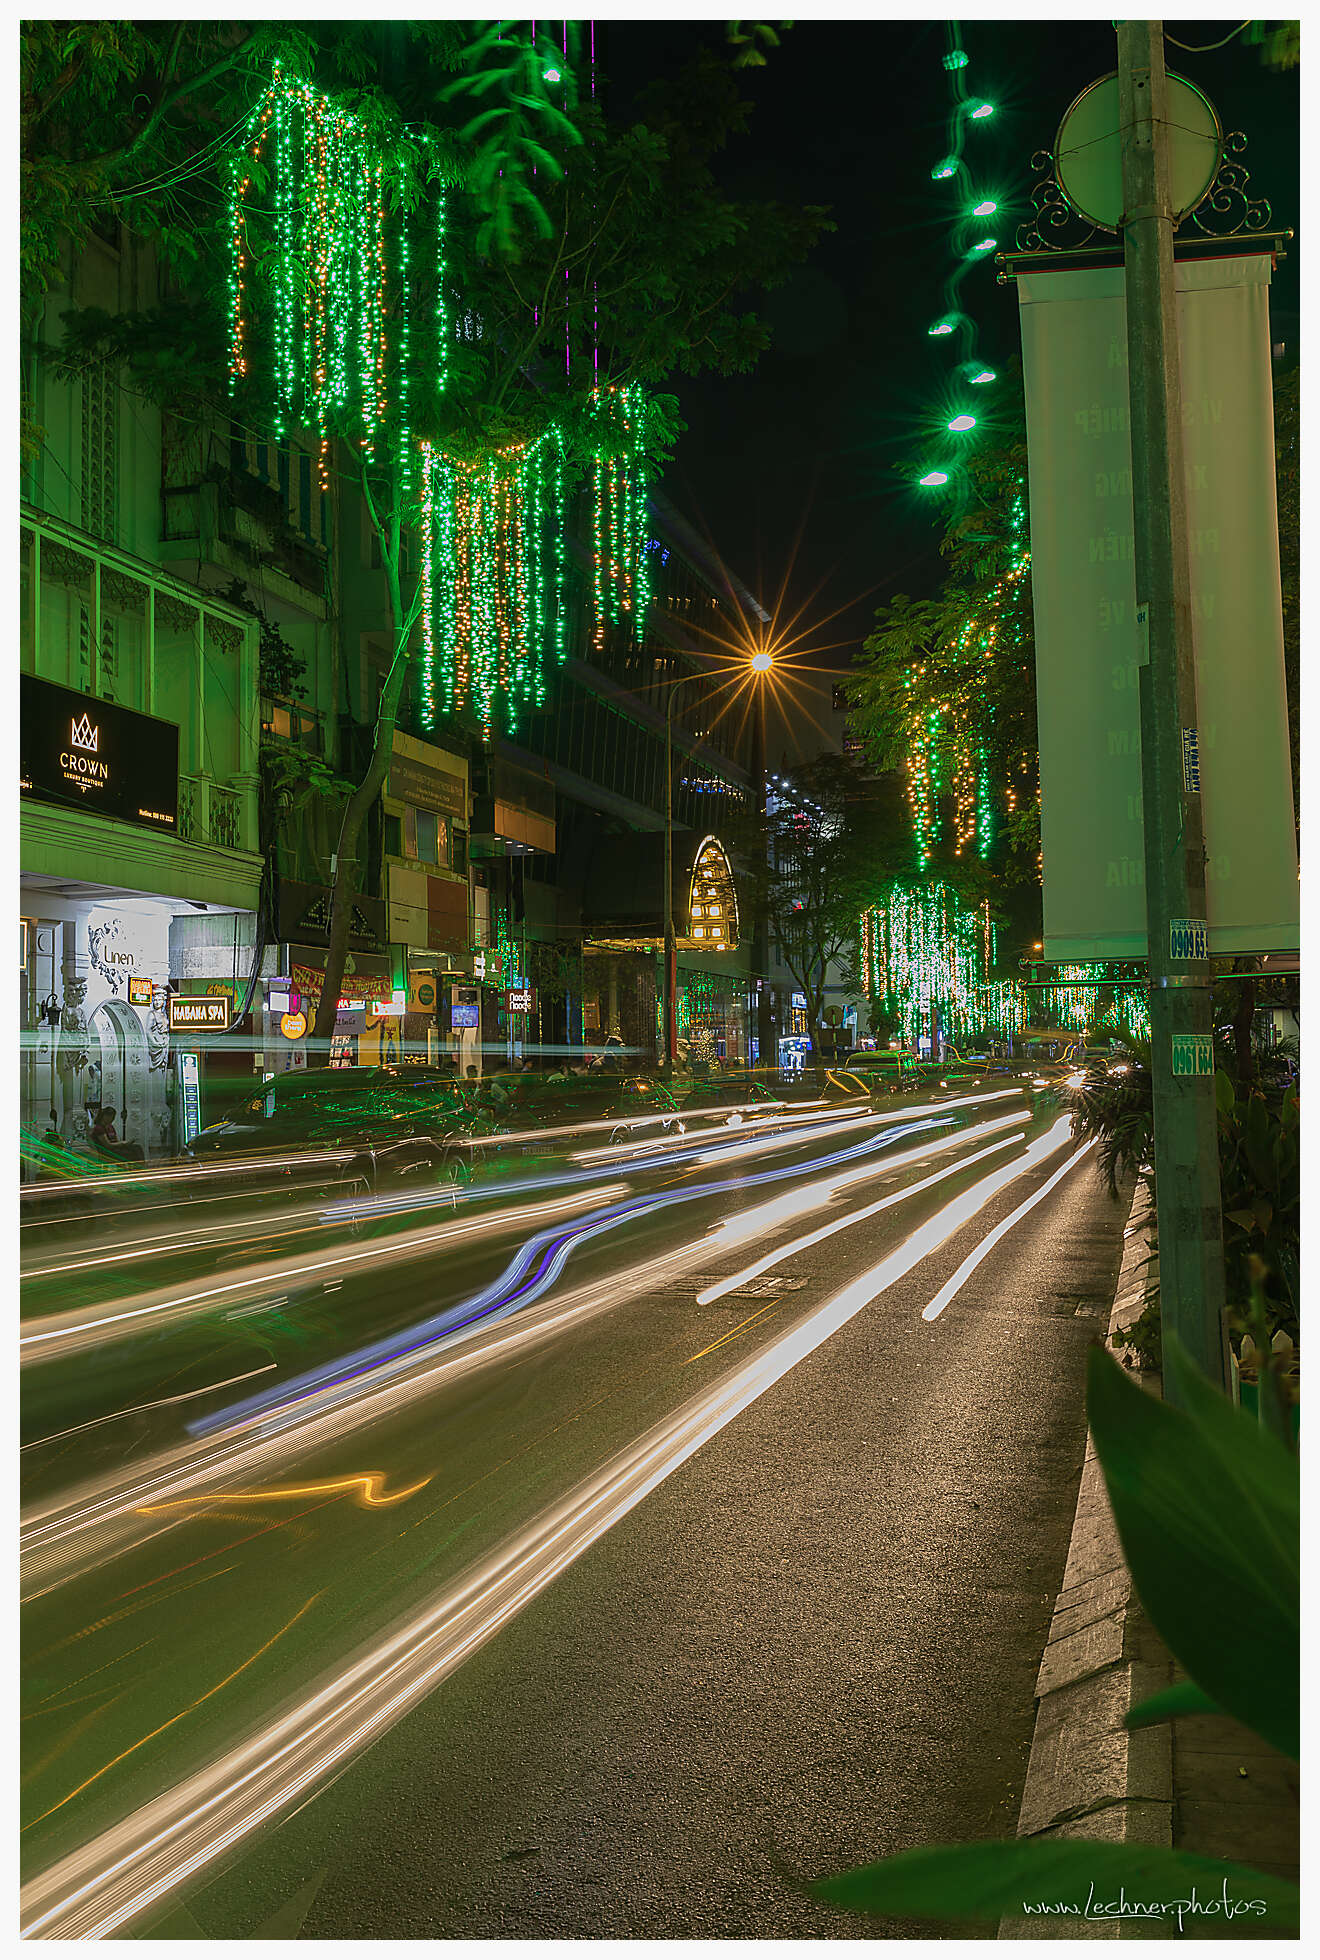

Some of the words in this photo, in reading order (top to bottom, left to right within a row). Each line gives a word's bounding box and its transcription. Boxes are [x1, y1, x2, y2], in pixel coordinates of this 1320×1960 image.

[60, 752, 108, 779] CROWN
[104, 945, 134, 966] Linen
[173, 1005, 207, 1021] HABANA
[208, 1004, 225, 1021] SPA
